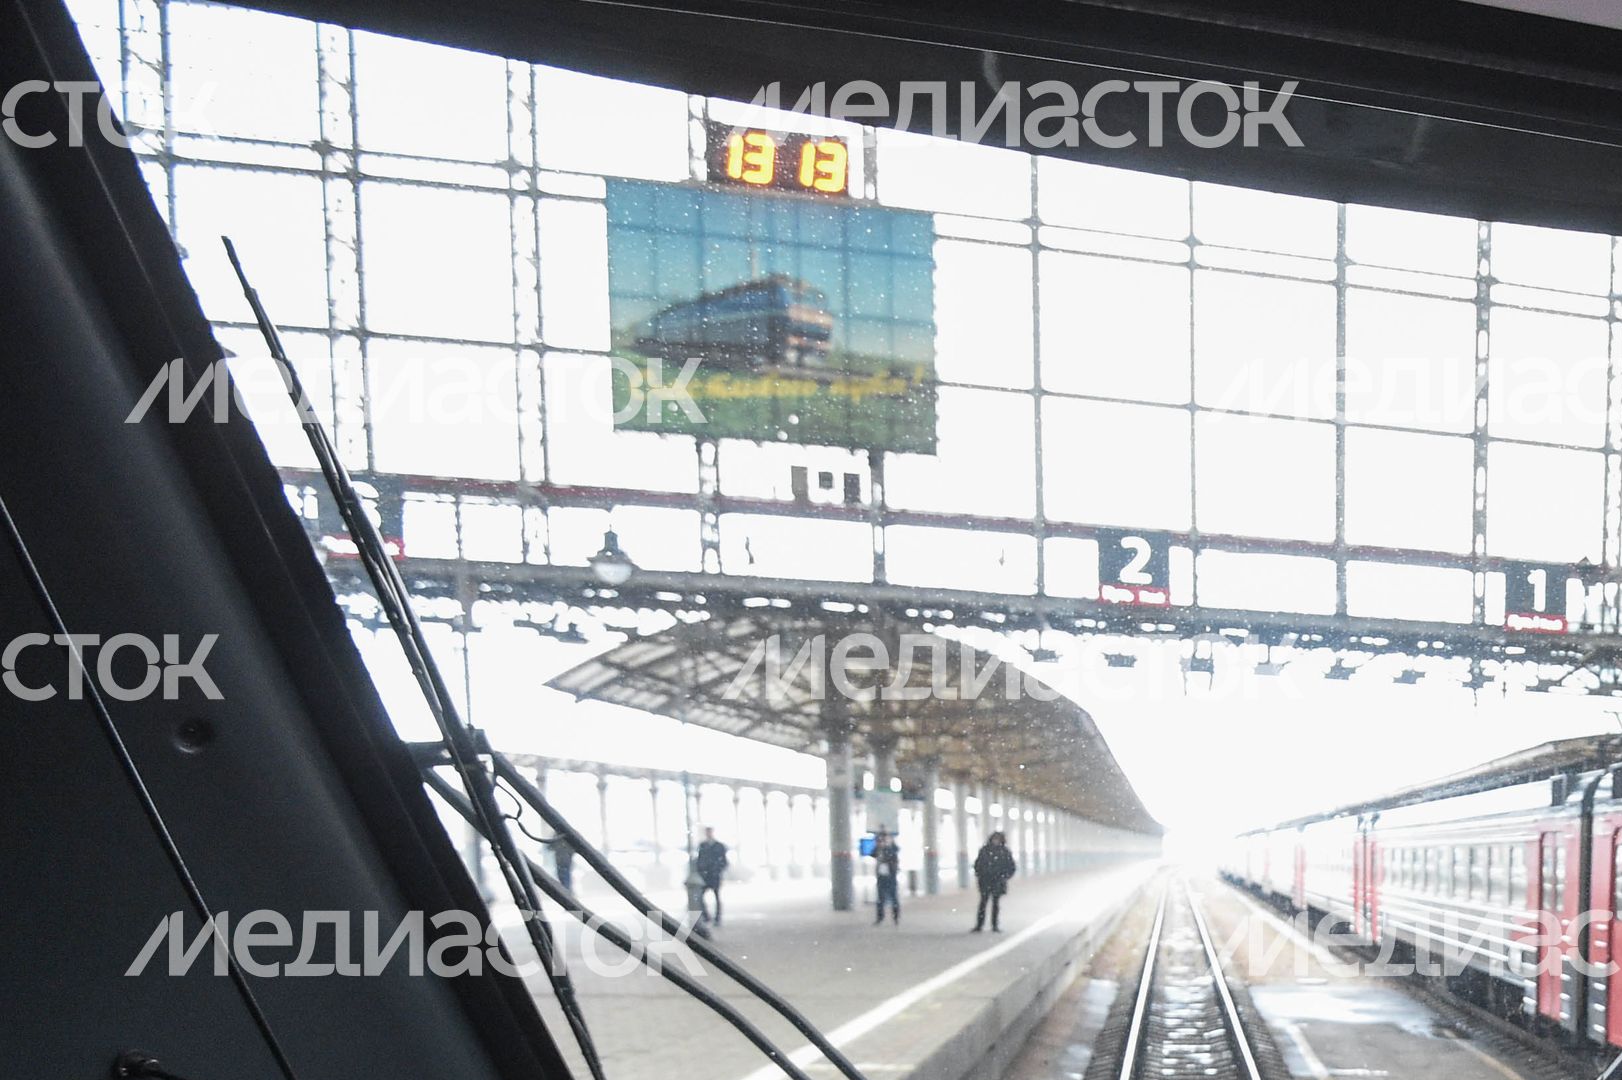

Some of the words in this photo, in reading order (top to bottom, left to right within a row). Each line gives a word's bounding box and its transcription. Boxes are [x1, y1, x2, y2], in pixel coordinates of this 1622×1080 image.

[727, 132, 775, 185] 13
[799, 140, 848, 193] 13
[1119, 536, 1153, 584] 2
[1527, 568, 1547, 612] 1
